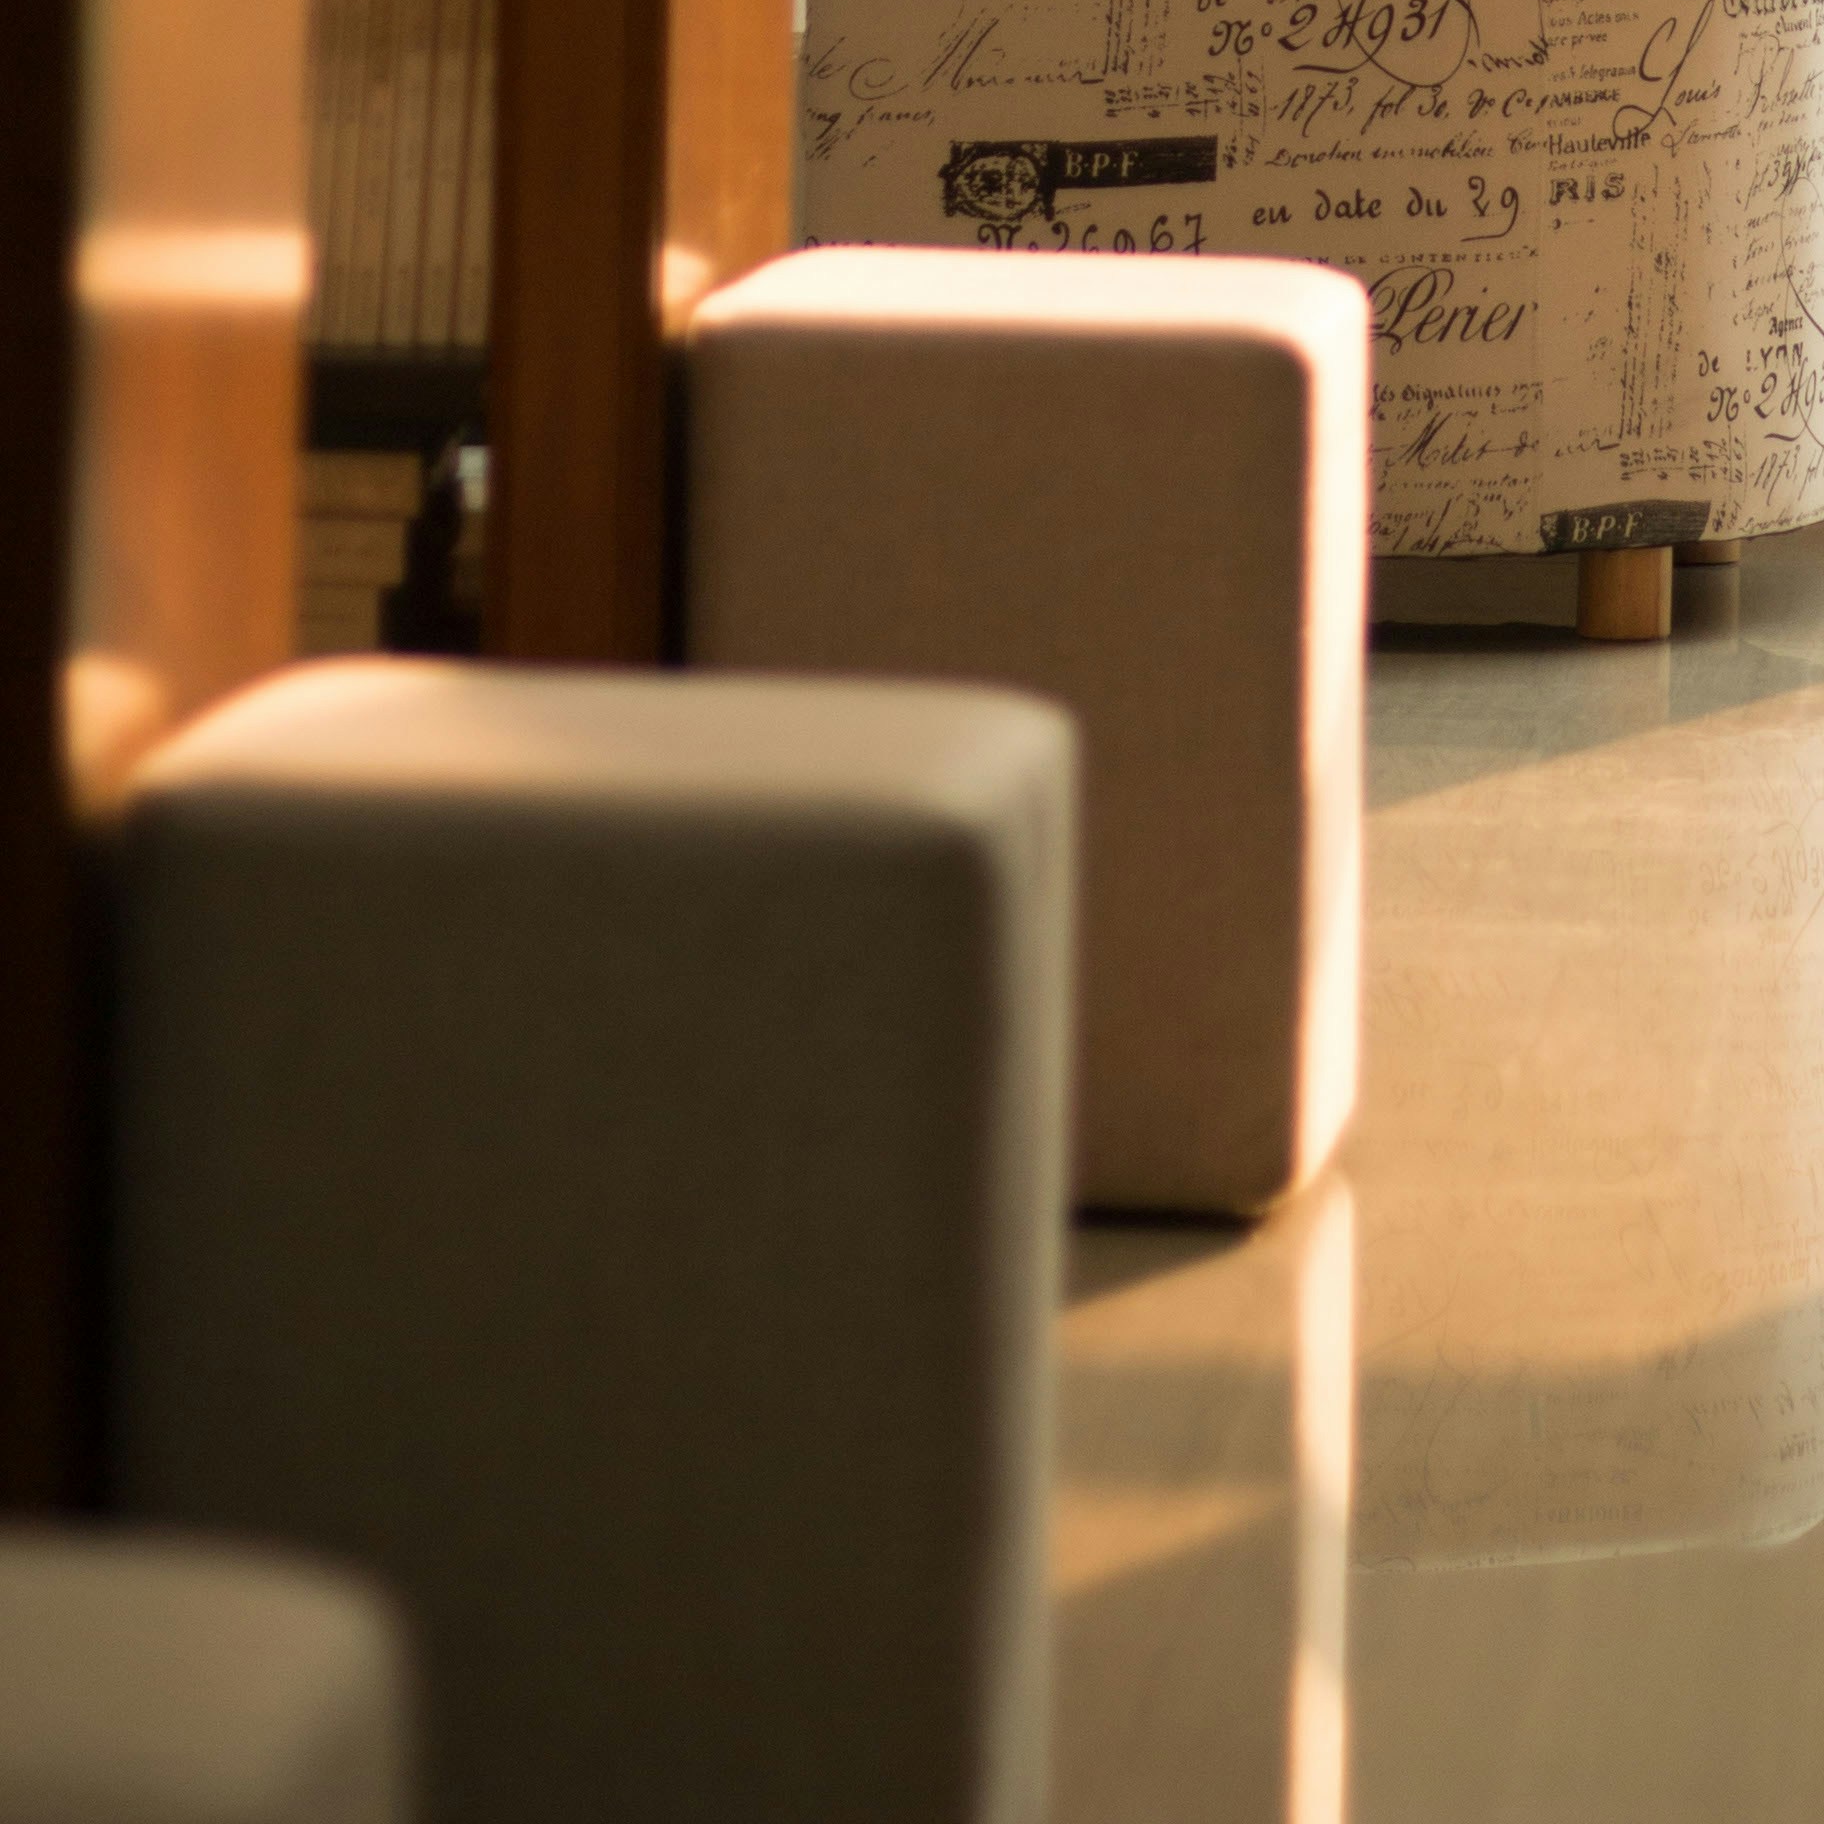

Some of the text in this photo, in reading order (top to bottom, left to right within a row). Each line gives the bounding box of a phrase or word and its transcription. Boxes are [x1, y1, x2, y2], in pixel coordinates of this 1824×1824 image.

[1252, 175, 1521, 243] en date du 29
